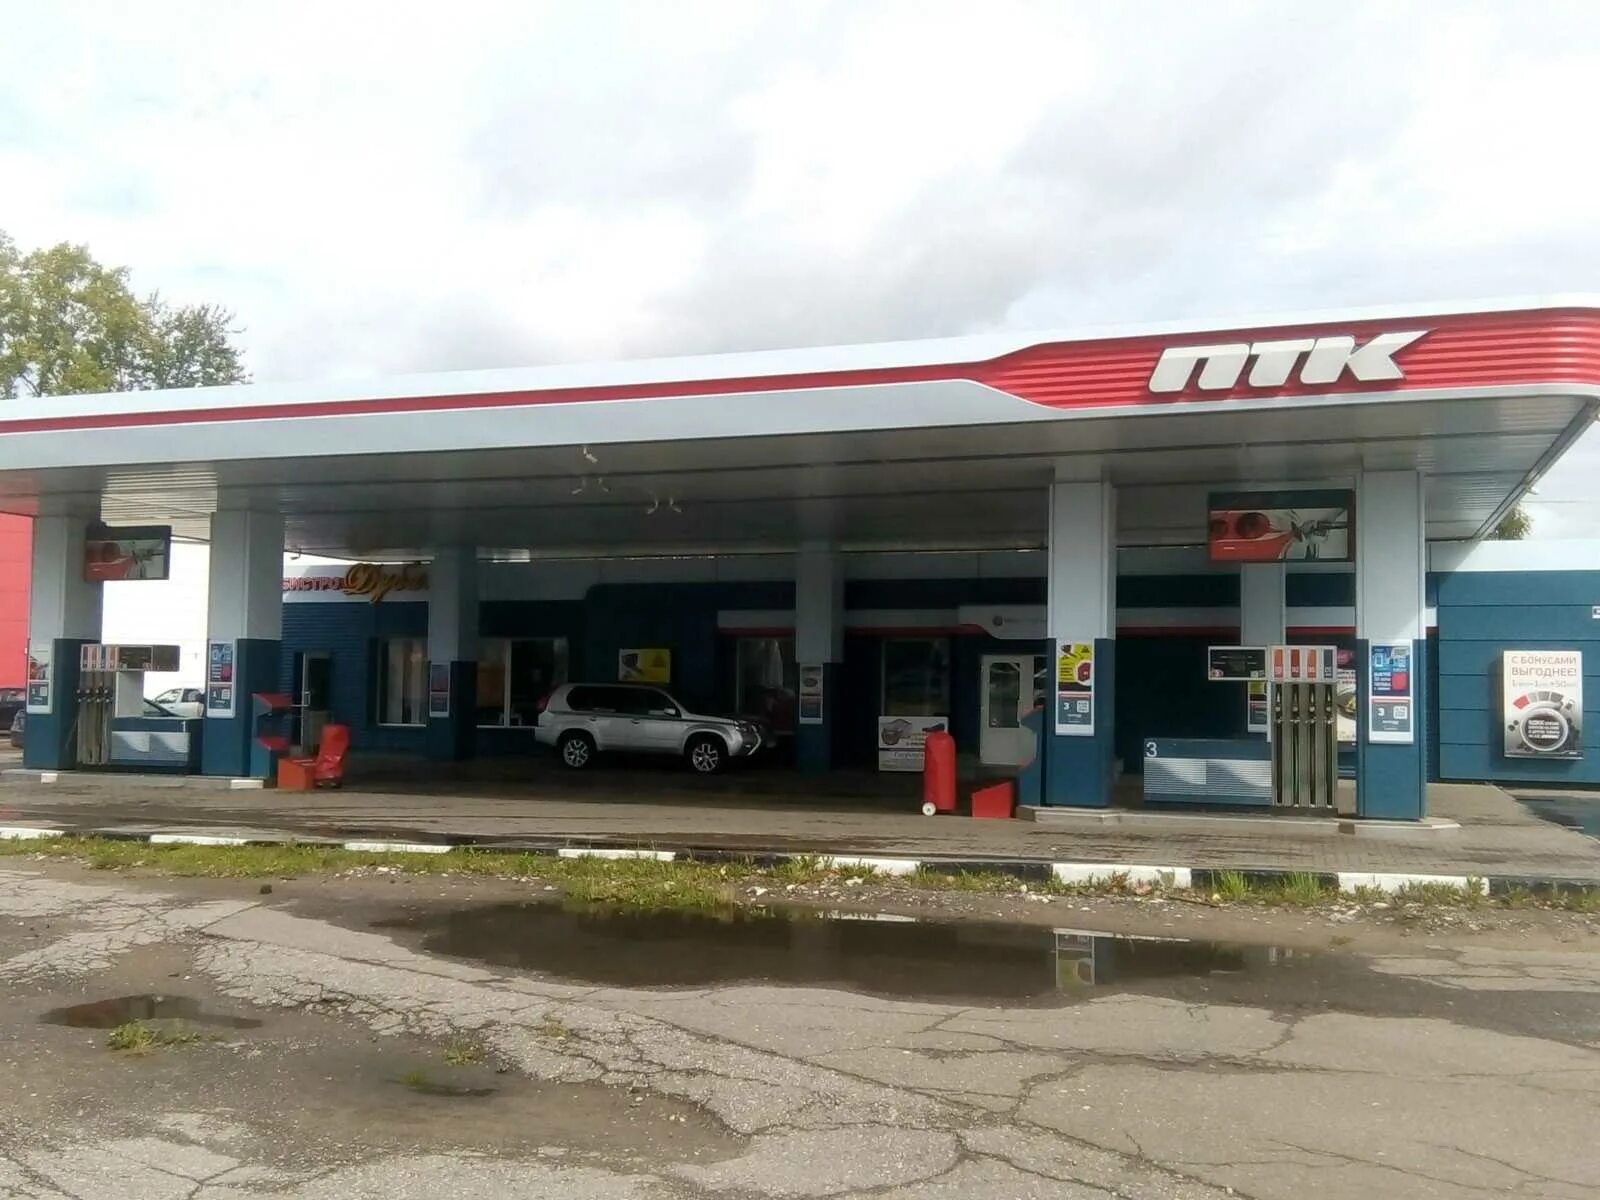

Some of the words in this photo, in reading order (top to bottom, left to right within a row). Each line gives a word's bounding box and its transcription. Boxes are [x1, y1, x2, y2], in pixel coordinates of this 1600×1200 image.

[1148, 329, 1428, 393] ПТК
[1512, 656, 1520, 664] С
[1521, 656, 1577, 665] БОНУСАМИ
[1512, 667, 1577, 678] ВЫГОДНЕЕ!
[1063, 702, 1070, 711] 3
[1377, 707, 1385, 717] 3
[1146, 741, 1157, 757] 3
